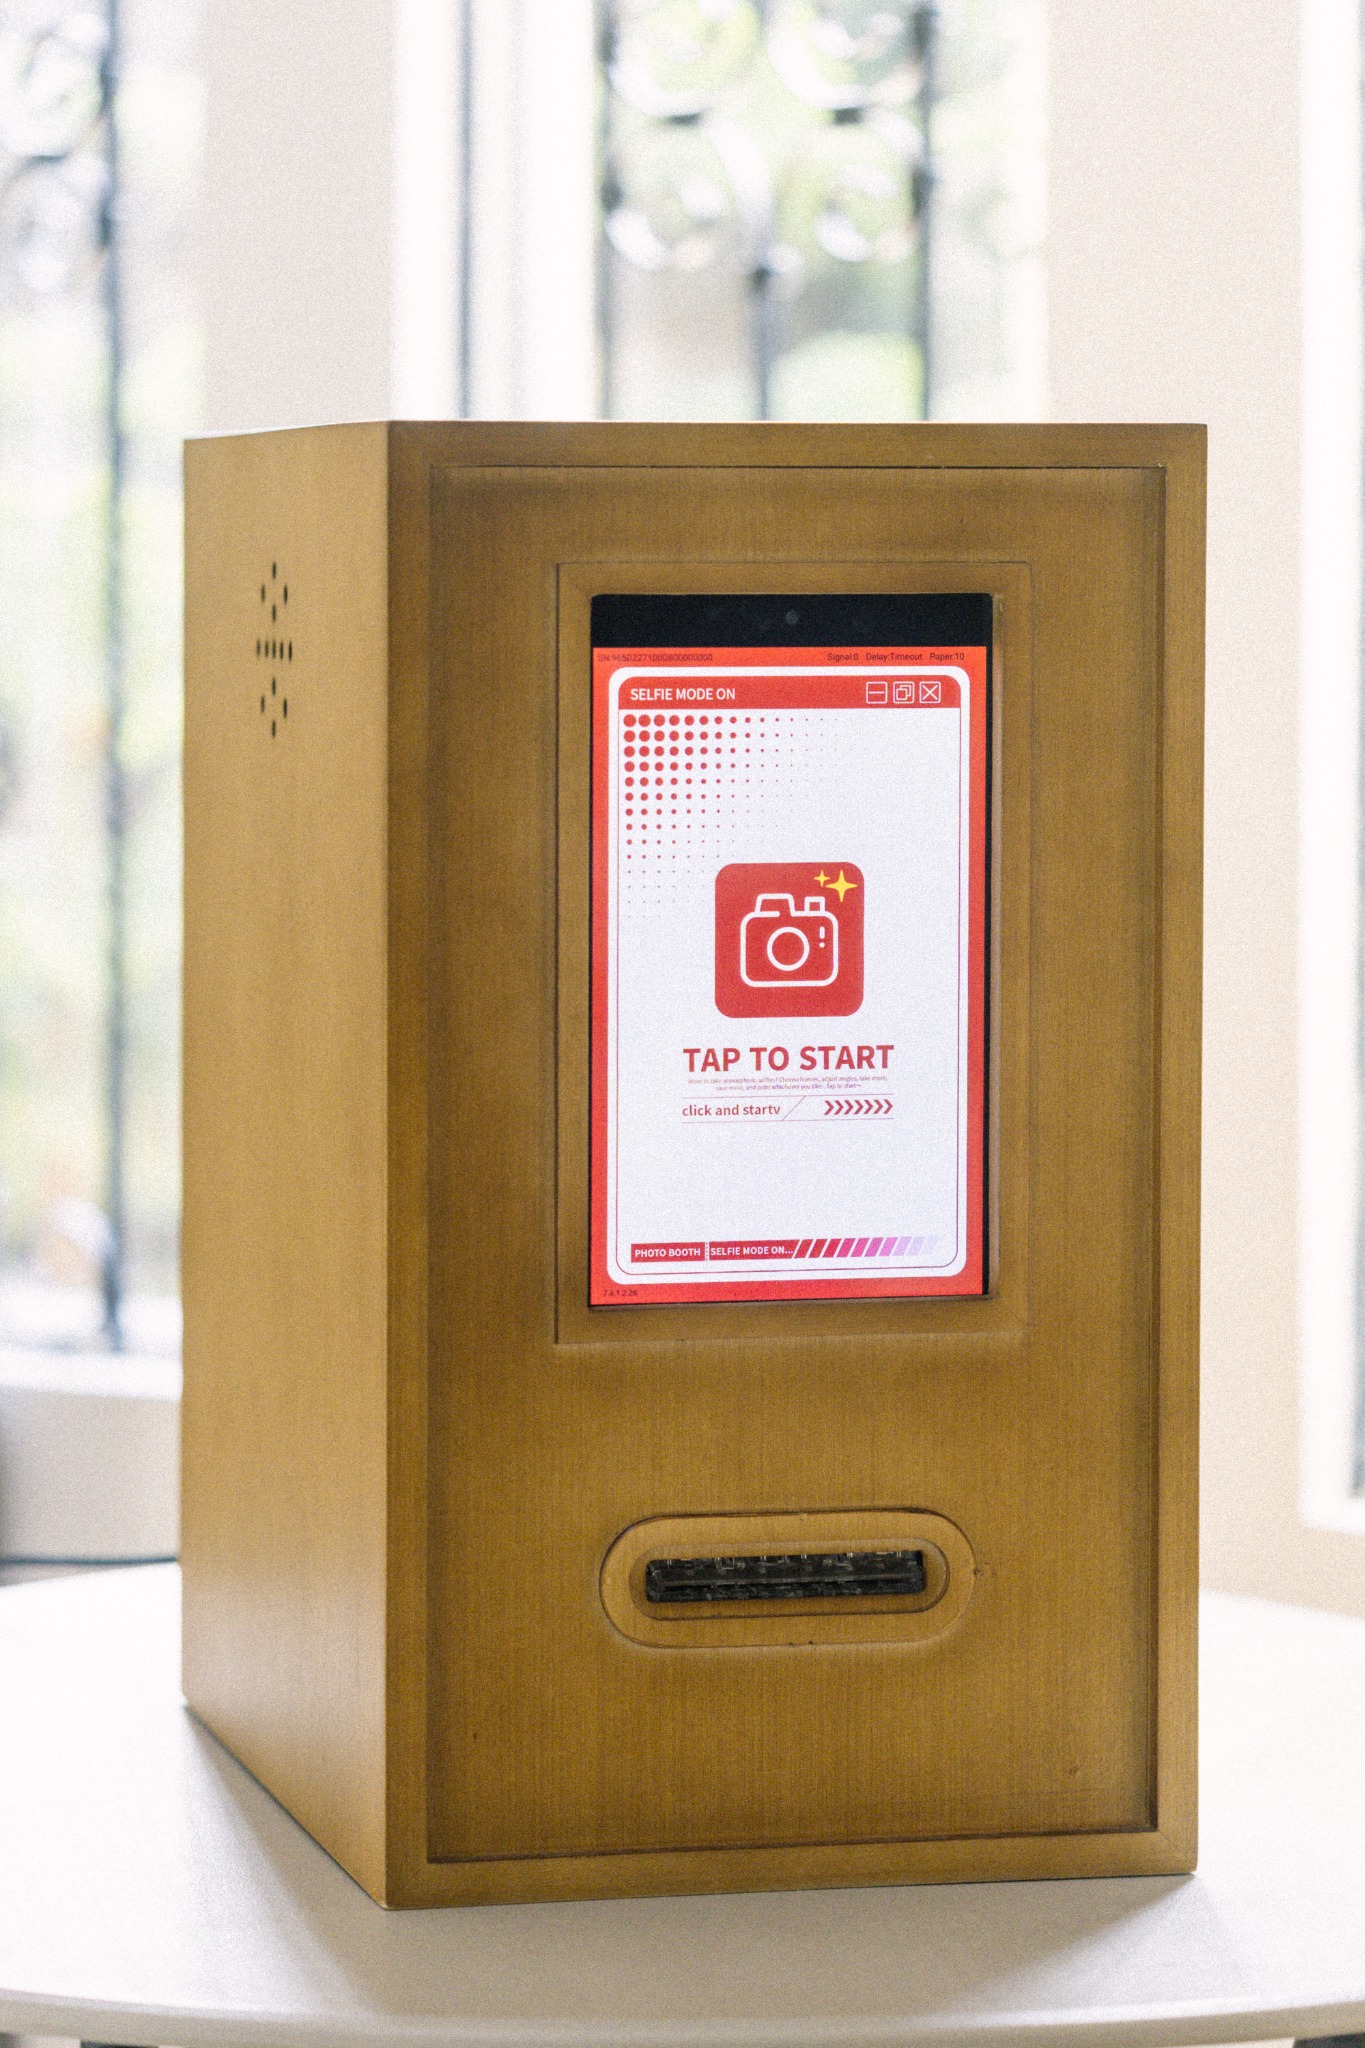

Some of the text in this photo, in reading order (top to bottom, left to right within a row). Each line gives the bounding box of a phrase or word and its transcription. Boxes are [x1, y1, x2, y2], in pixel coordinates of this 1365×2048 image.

[631, 688, 735, 700] SELFIE MODE ON
[682, 1045, 895, 1072] TAP TO START
[682, 1104, 780, 1116] click and startv
[635, 1247, 701, 1258] PHOTO BOOTH
[710, 1245, 794, 1256] SELFIE MODE ON...
